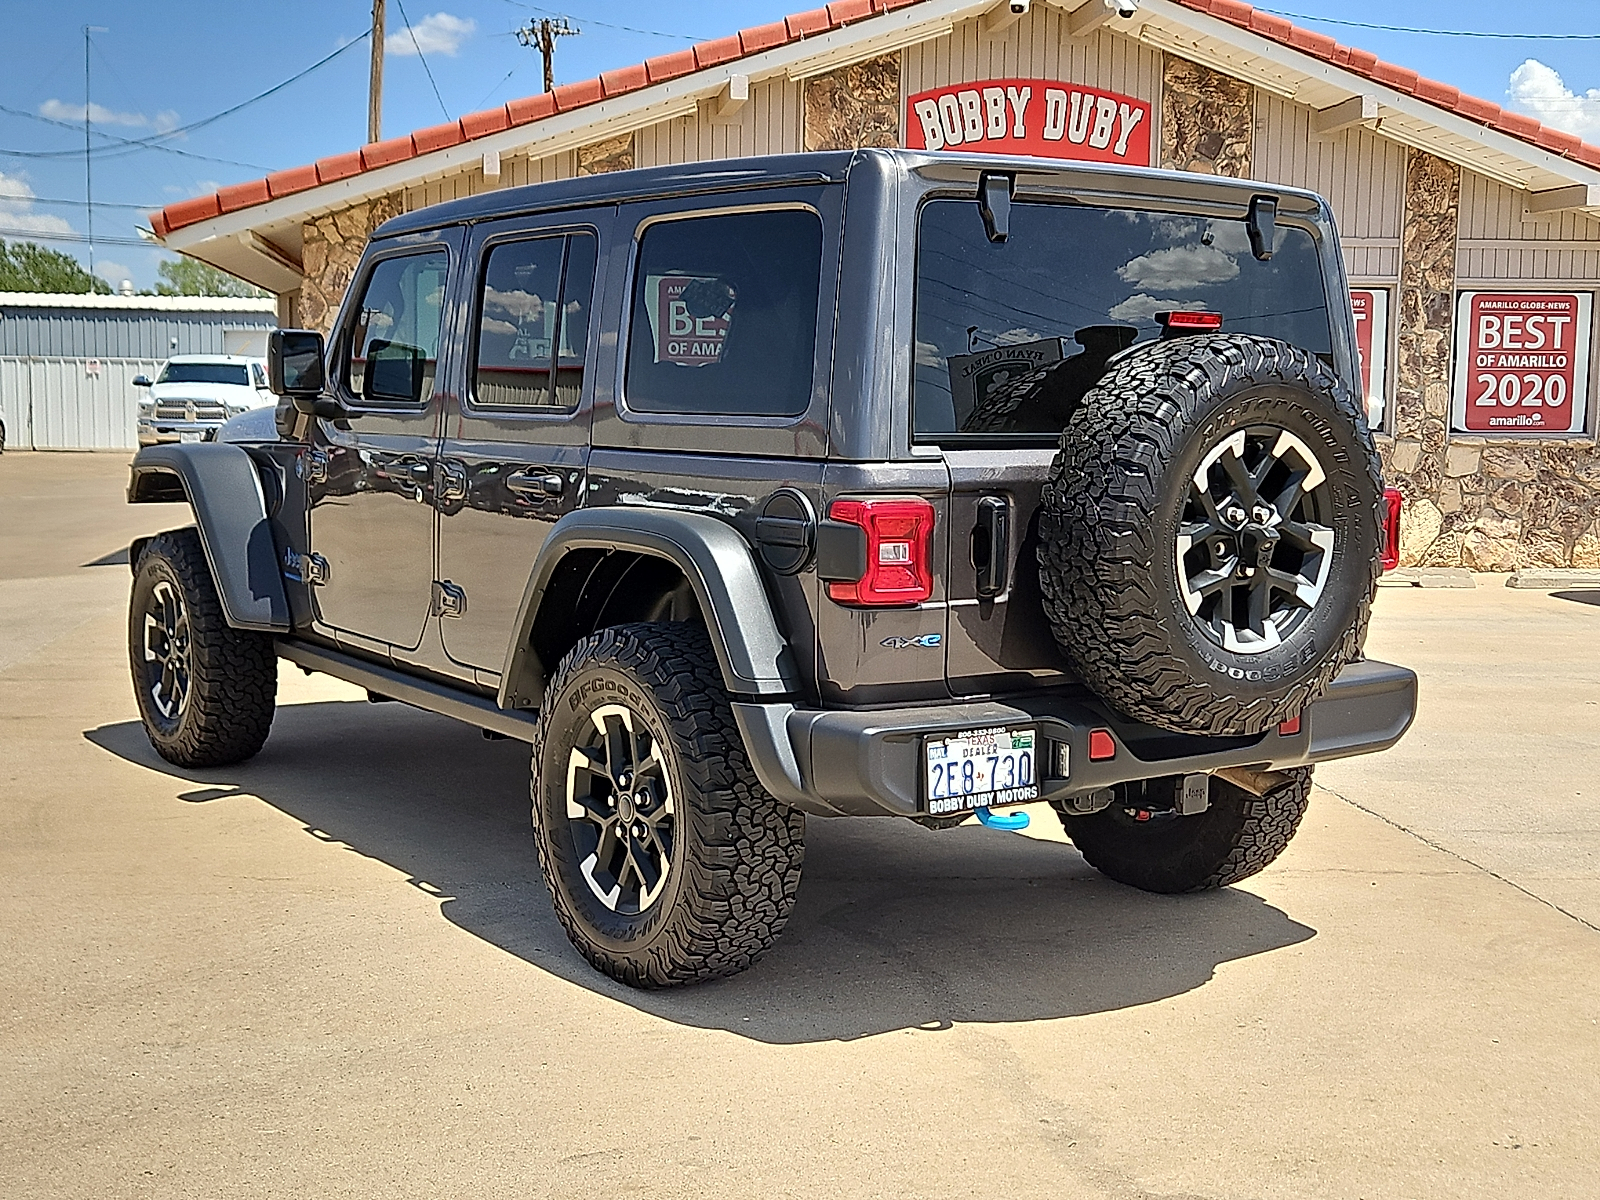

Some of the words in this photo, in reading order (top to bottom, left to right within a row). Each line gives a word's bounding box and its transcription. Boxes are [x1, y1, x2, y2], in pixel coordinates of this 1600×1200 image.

[914, 86, 1031, 151] BOBBY
[1042, 88, 1144, 156] DUBY
[1479, 301, 1519, 309] AMARILLO
[1520, 302, 1571, 310] GLOBE-NEWS
[1478, 315, 1571, 349] BEST
[667, 342, 688, 355] OF
[1476, 355, 1495, 367] OF
[1497, 355, 1567, 368] AMARILLO
[1475, 373, 1567, 407] 2020
[967, 735, 995, 746] TEXAS
[963, 744, 998, 758] DEALER
[930, 797, 965, 814] BOBBY
[967, 791, 995, 808] DUBY
[996, 786, 1038, 804] MOTORS
